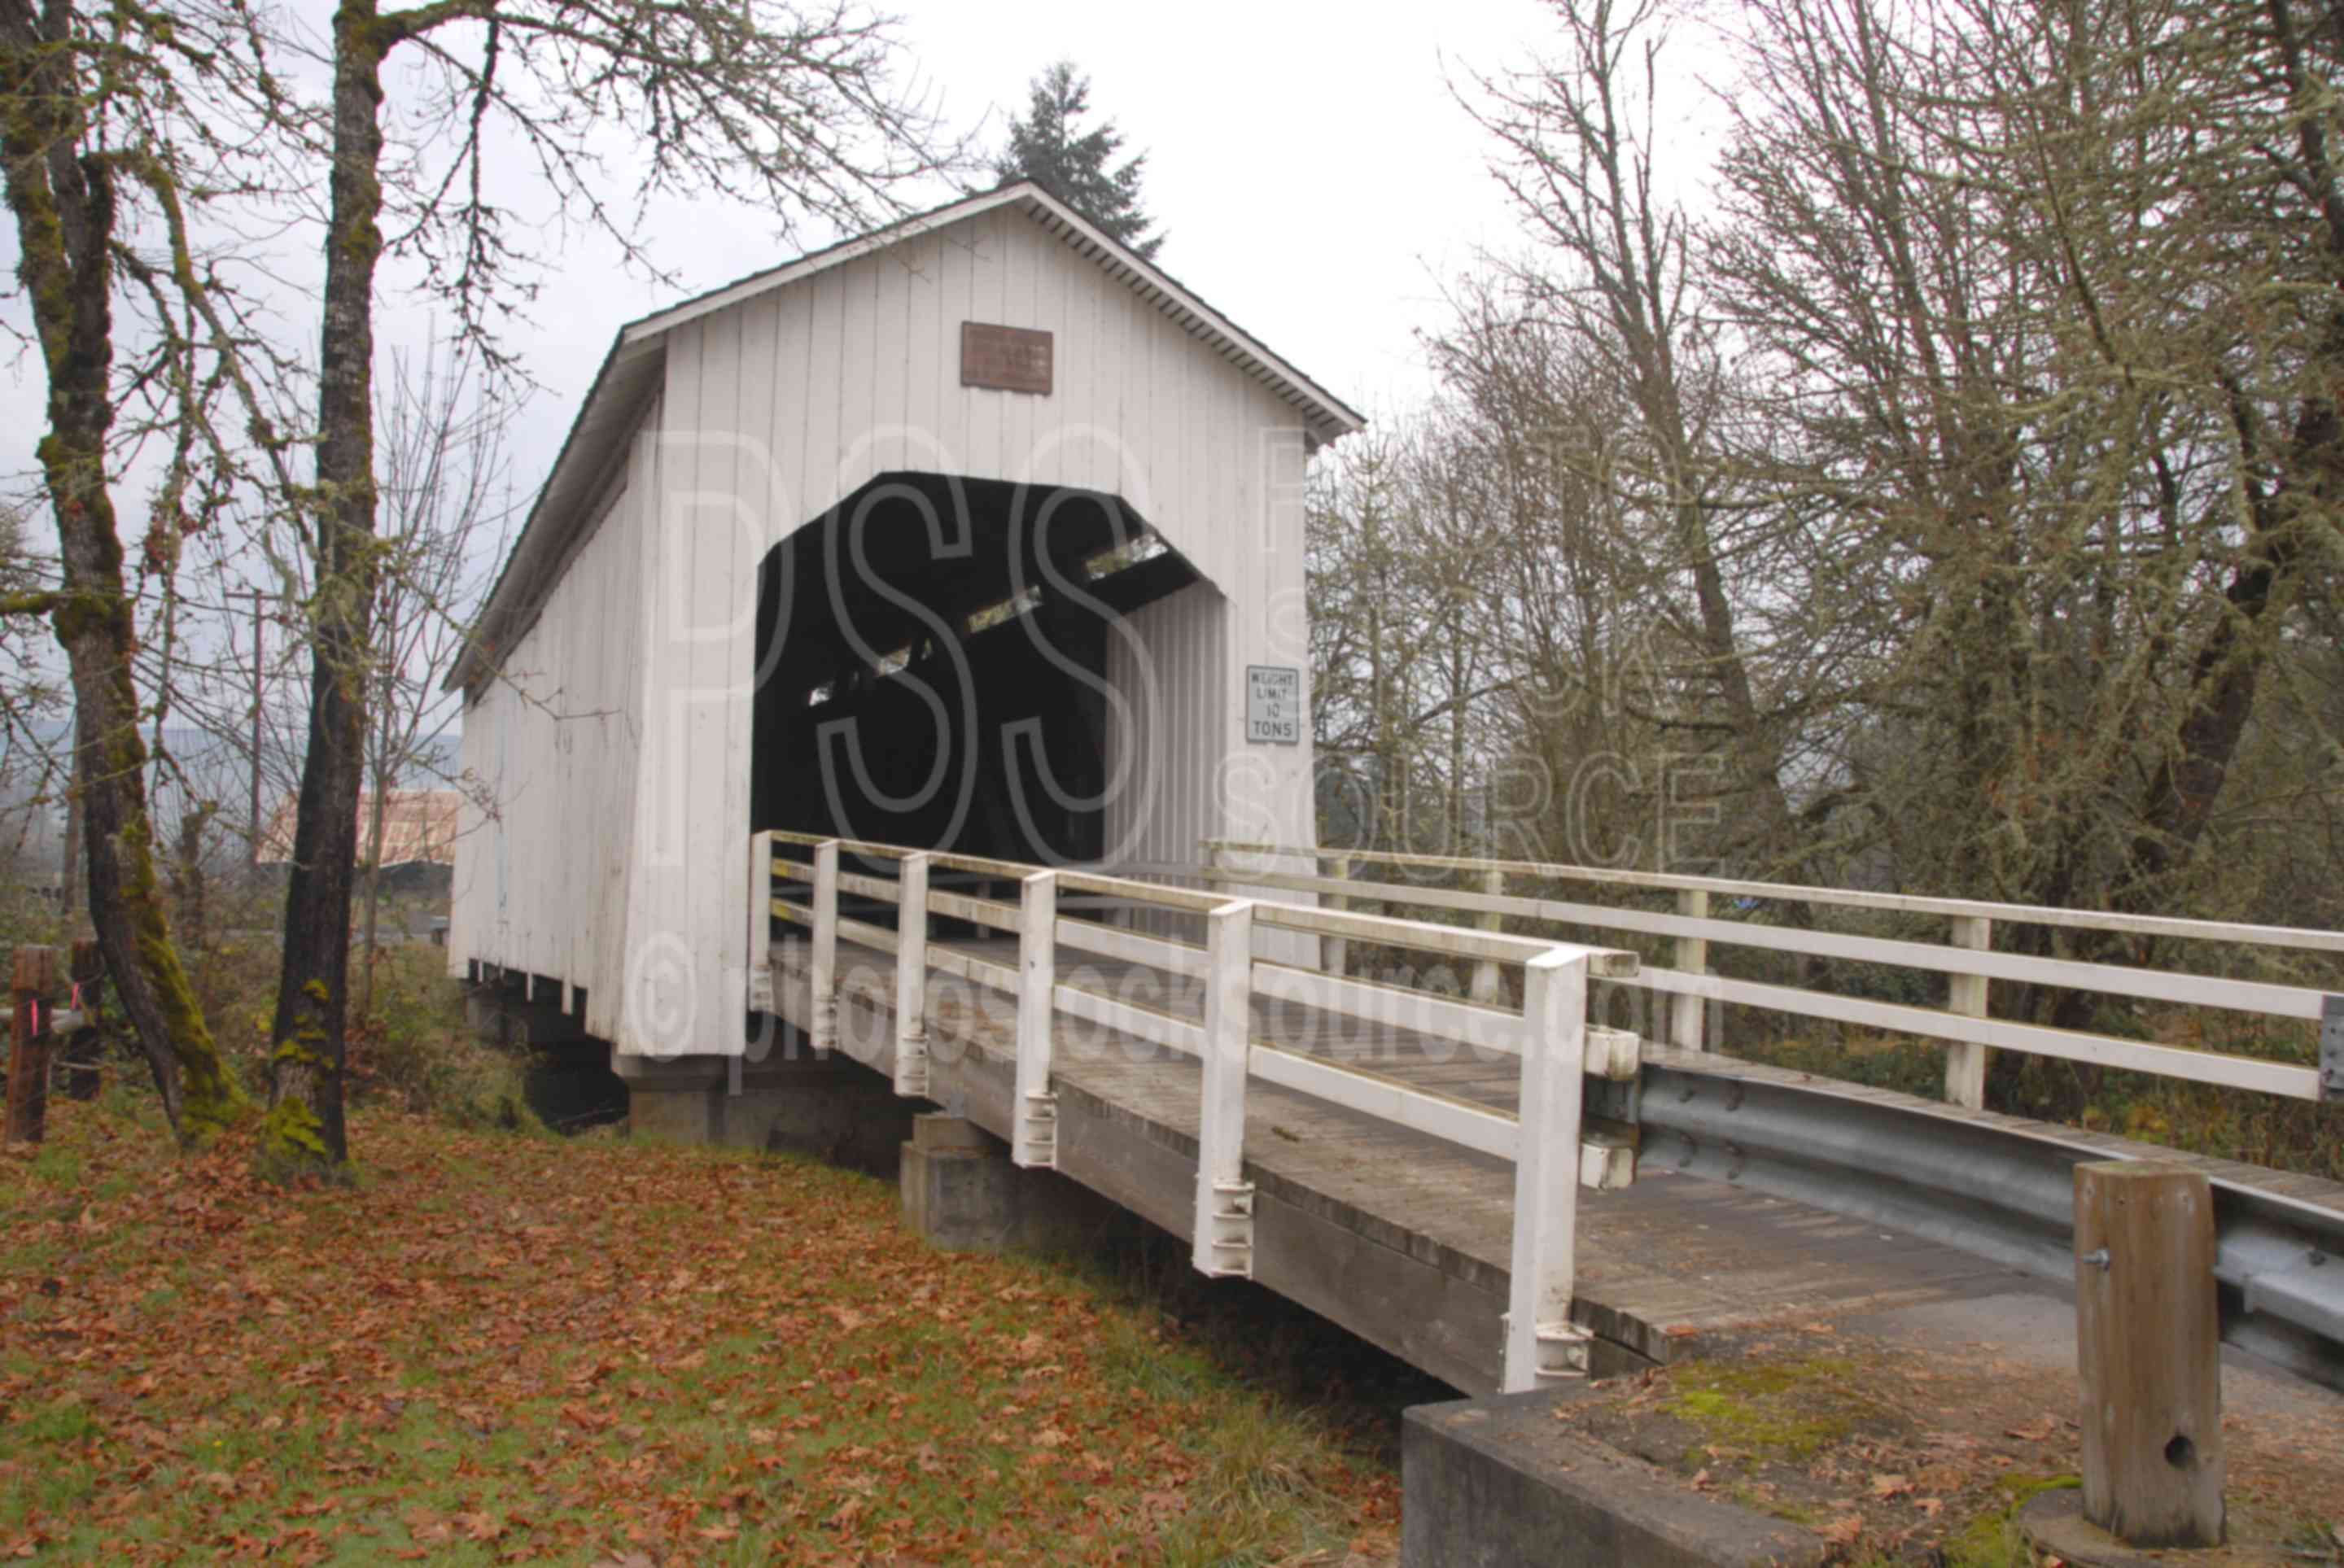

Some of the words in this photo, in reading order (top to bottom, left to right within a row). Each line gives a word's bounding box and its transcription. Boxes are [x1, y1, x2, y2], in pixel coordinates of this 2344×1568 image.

[1252, 672, 1293, 686] WEIGHT
[1257, 688, 1287, 700] LIMIT
[1266, 702, 1280, 718] 10
[1253, 721, 1292, 737] TONS
